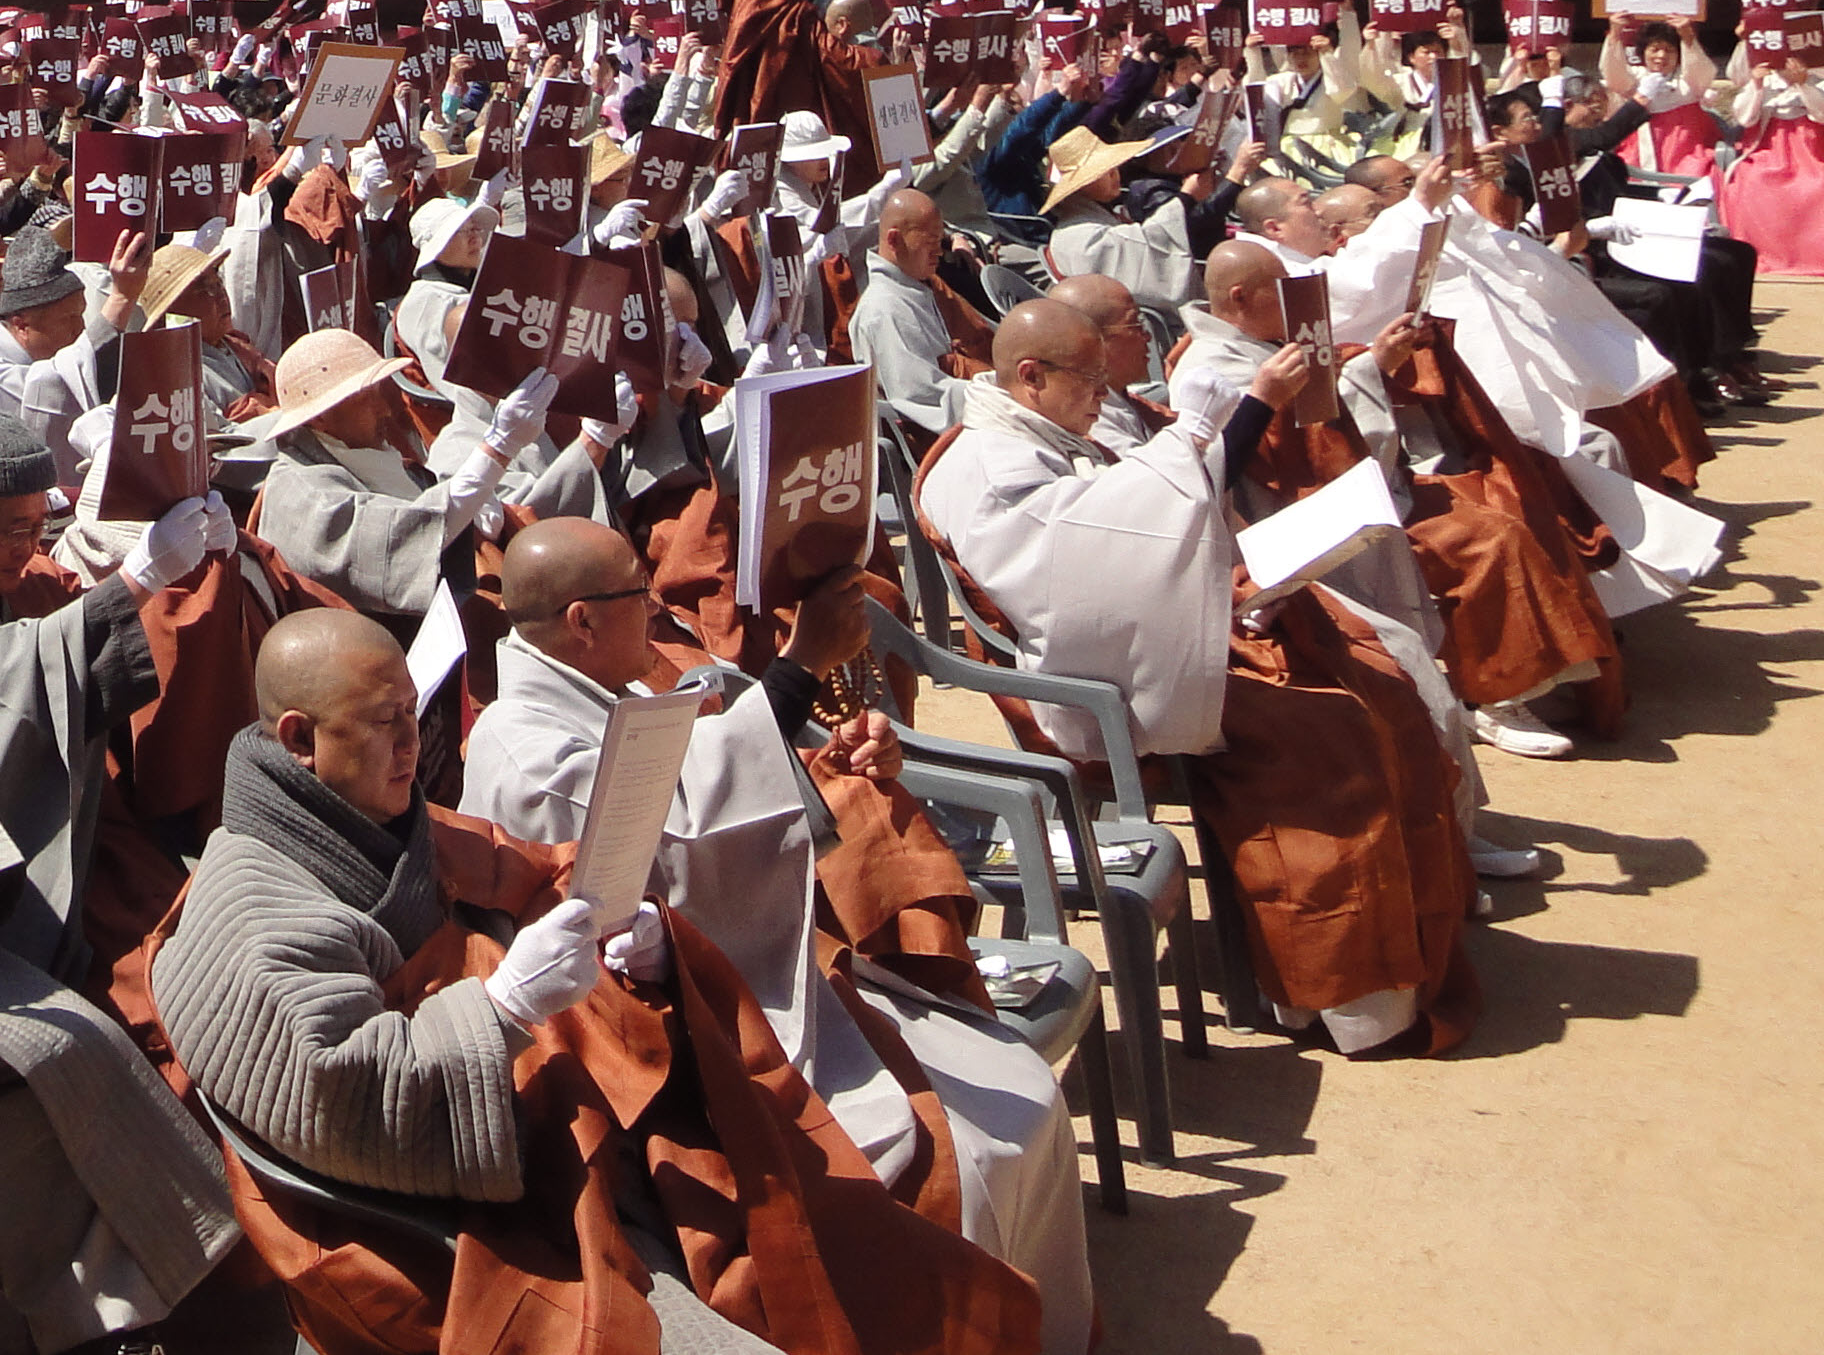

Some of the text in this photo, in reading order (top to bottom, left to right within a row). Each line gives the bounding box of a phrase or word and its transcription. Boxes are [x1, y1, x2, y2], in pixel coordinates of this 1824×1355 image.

[436, 0, 462, 18] 수행
[1165, 5, 1192, 26] 결사
[1257, 7, 1321, 28] 수행 결사
[195, 15, 216, 33] 수행
[354, 23, 374, 41] 수행
[545, 20, 572, 45] 수행
[1211, 27, 1231, 47] 수행
[1510, 13, 1571, 37] 수행 결사
[106, 36, 136, 60] 수행
[150, 38, 171, 59] 수행
[480, 38, 505, 61] 결사
[656, 36, 677, 54] 수행
[933, 35, 1008, 64] 수행 결사
[1749, 31, 1822, 50] 수행 결사
[37, 58, 72, 84] 수행
[397, 56, 422, 80] 수행
[315, 82, 379, 109] 문화결사
[539, 102, 572, 130] 수행
[376, 119, 405, 151] 수행
[488, 125, 512, 154] 수행
[640, 155, 684, 191] 수행
[737, 150, 767, 183] 수행
[169, 163, 213, 197] 수행
[1539, 164, 1573, 198] 수행
[84, 171, 148, 217] 수행
[529, 177, 574, 212] 수행
[481, 287, 613, 365] 수행 결사
[1295, 319, 1331, 368] 수행
[130, 383, 195, 455] 수행
[778, 441, 864, 522] 수행
